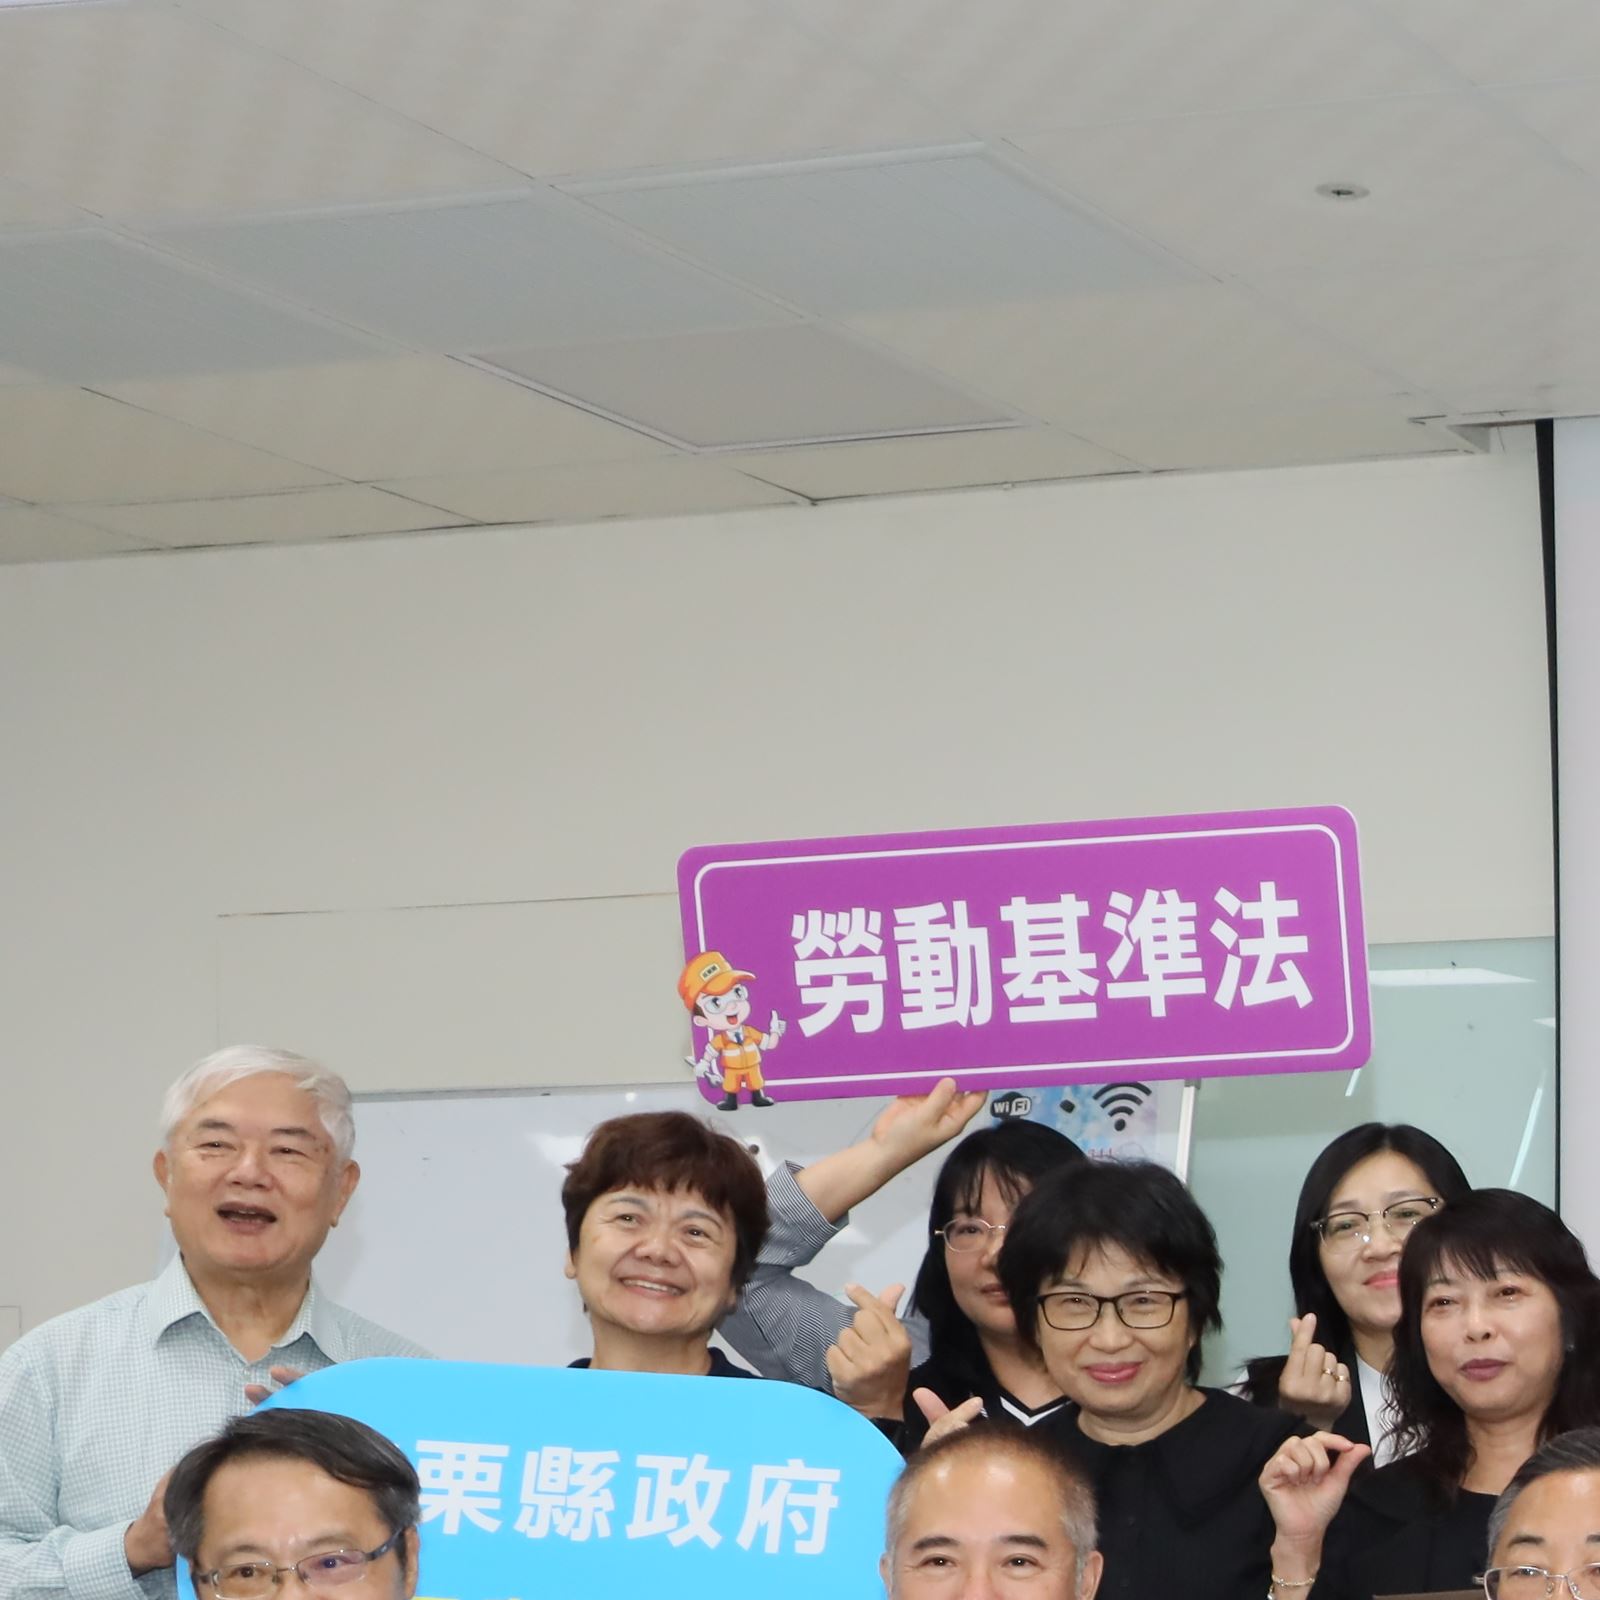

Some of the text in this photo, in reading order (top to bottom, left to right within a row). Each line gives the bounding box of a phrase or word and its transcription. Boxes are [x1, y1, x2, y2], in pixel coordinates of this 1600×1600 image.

[791, 881, 1313, 1039] 勞動基準法
